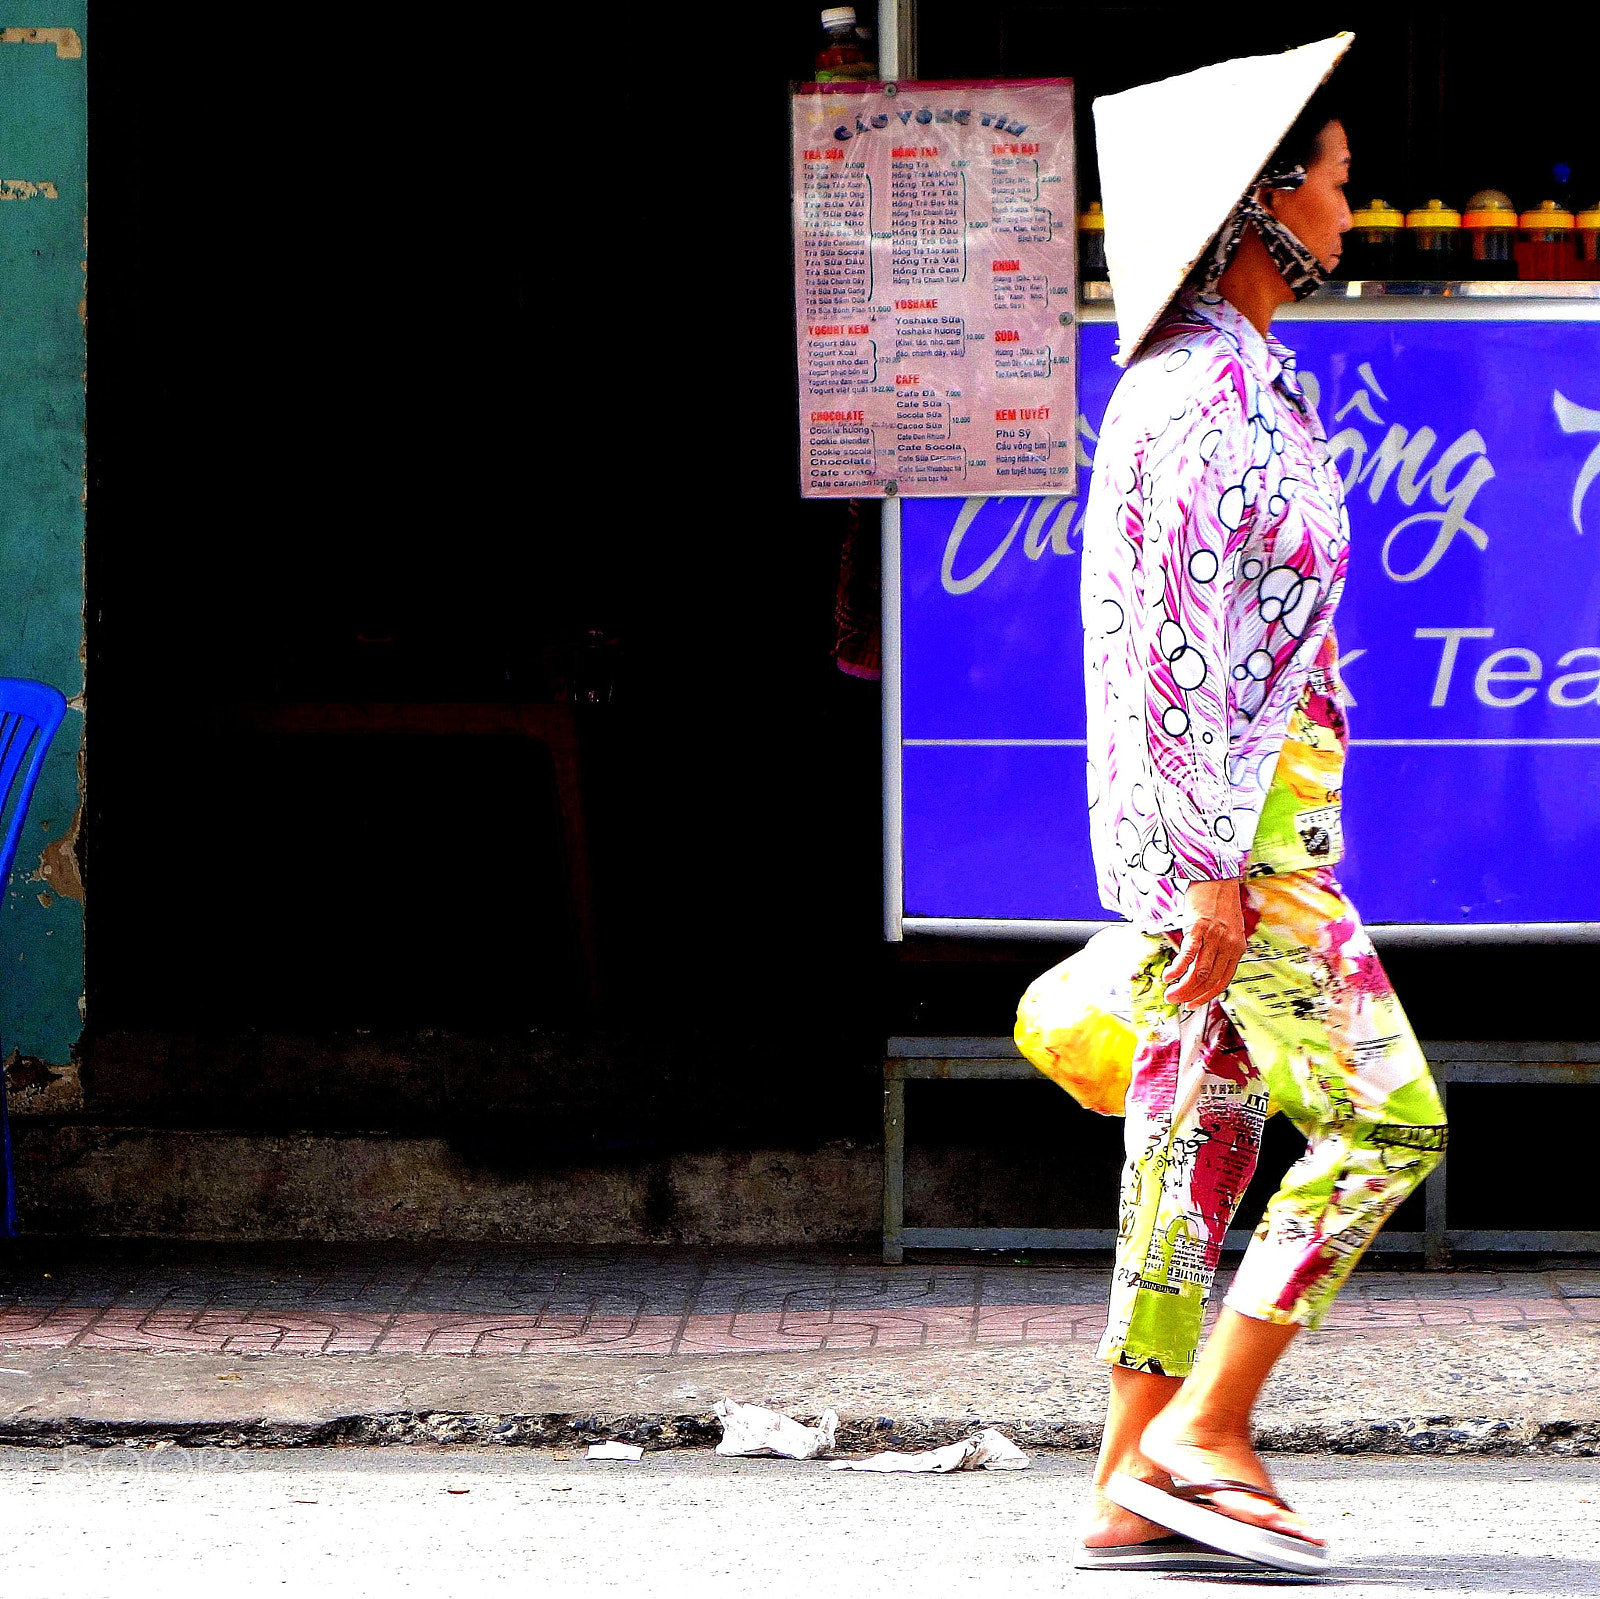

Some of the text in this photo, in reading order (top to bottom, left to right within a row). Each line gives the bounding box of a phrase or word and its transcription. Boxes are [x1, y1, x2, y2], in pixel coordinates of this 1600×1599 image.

[895, 299, 938, 310] YOSHAKE
[895, 316, 938, 325] Yoshake
[808, 325, 844, 336] YOGURT
[895, 327, 932, 336] Yoshake
[995, 330, 1020, 342] SODA
[895, 373, 920, 385] CAFE
[811, 410, 865, 421] CHOCOLATE
[995, 405, 1050, 421] KEM TUYẾT
[925, 443, 962, 451] Socola
[810, 458, 872, 466] Chocolate
[1297, 362, 1496, 583] ồng
[1414, 627, 1600, 707] Tea
